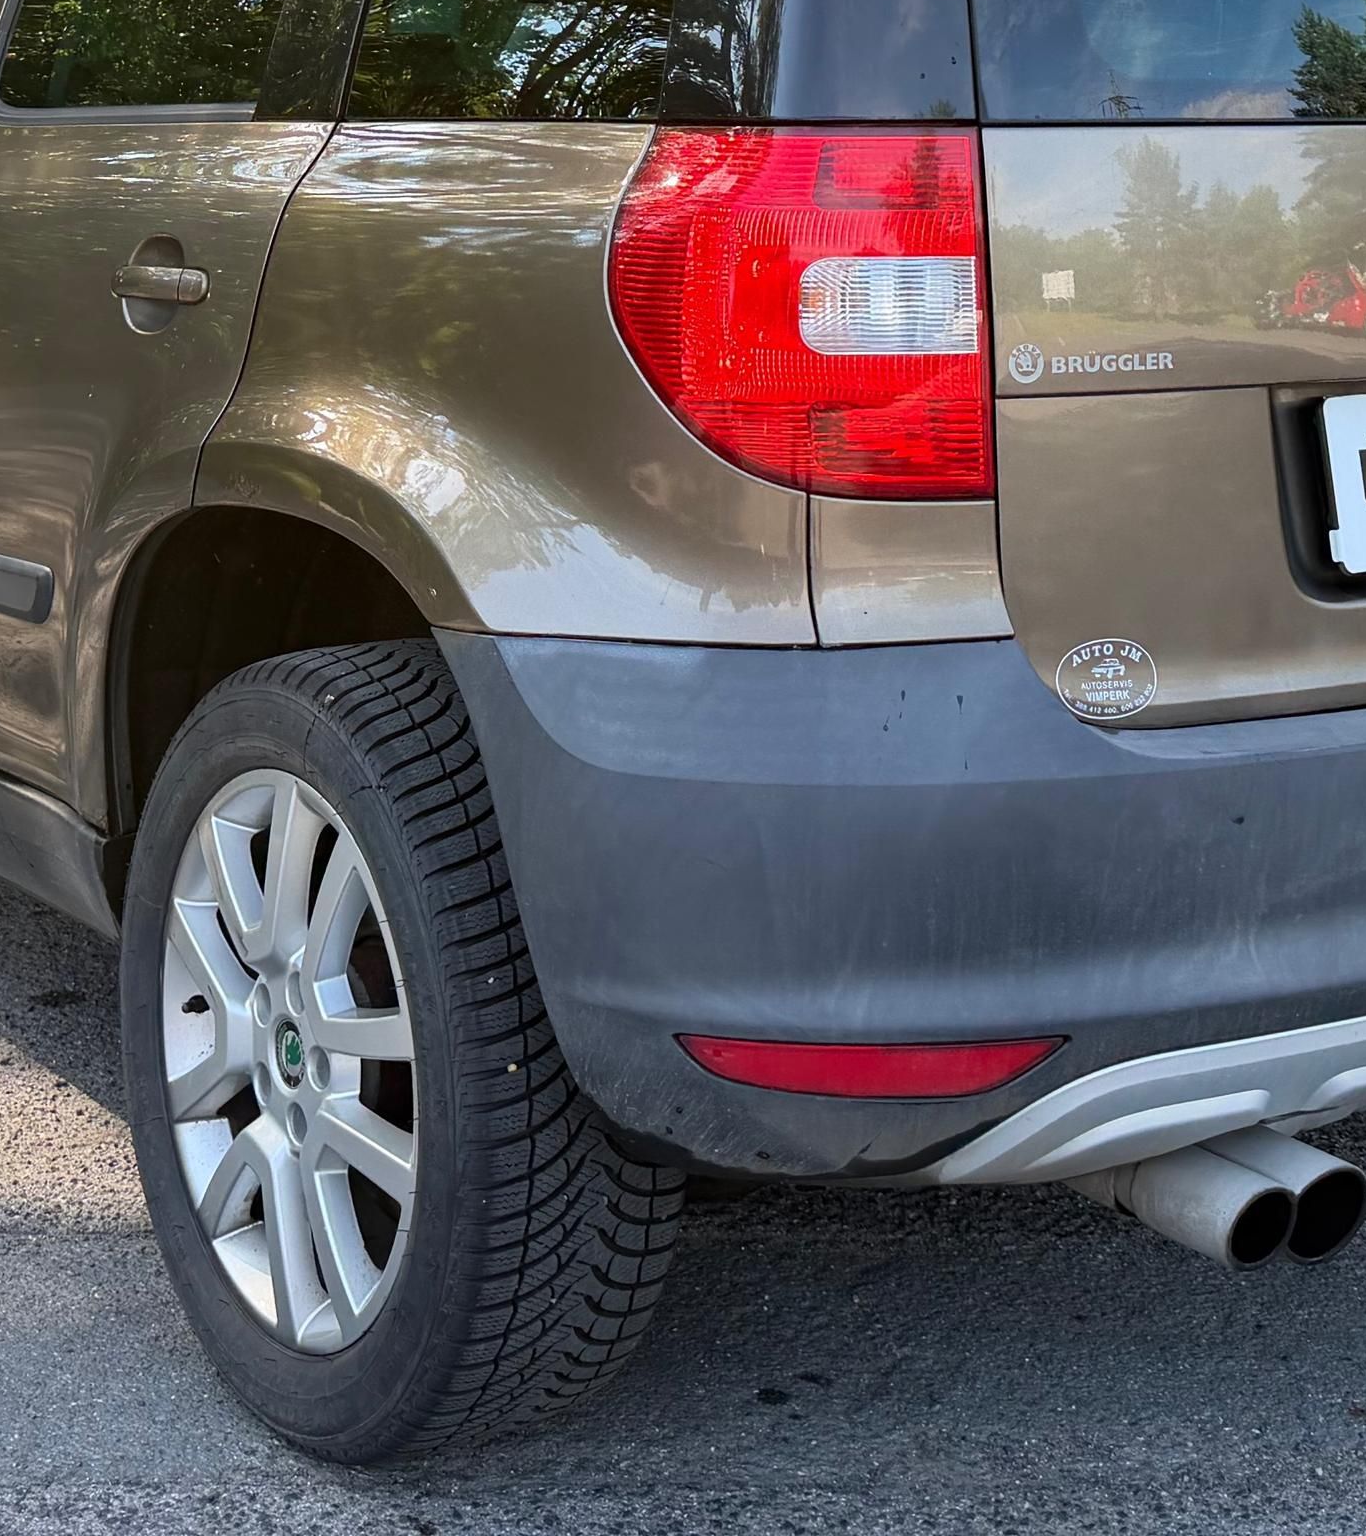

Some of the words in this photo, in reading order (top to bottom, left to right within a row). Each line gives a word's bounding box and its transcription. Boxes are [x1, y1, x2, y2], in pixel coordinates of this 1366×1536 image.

[1051, 350, 1174, 374] BRÜGGLER
[1071, 643, 1114, 667] AUTO
[1120, 645, 1143, 663] JM
[1080, 679, 1133, 690] AUTOSERVIS
[1085, 690, 1131, 702] VIMPERK
